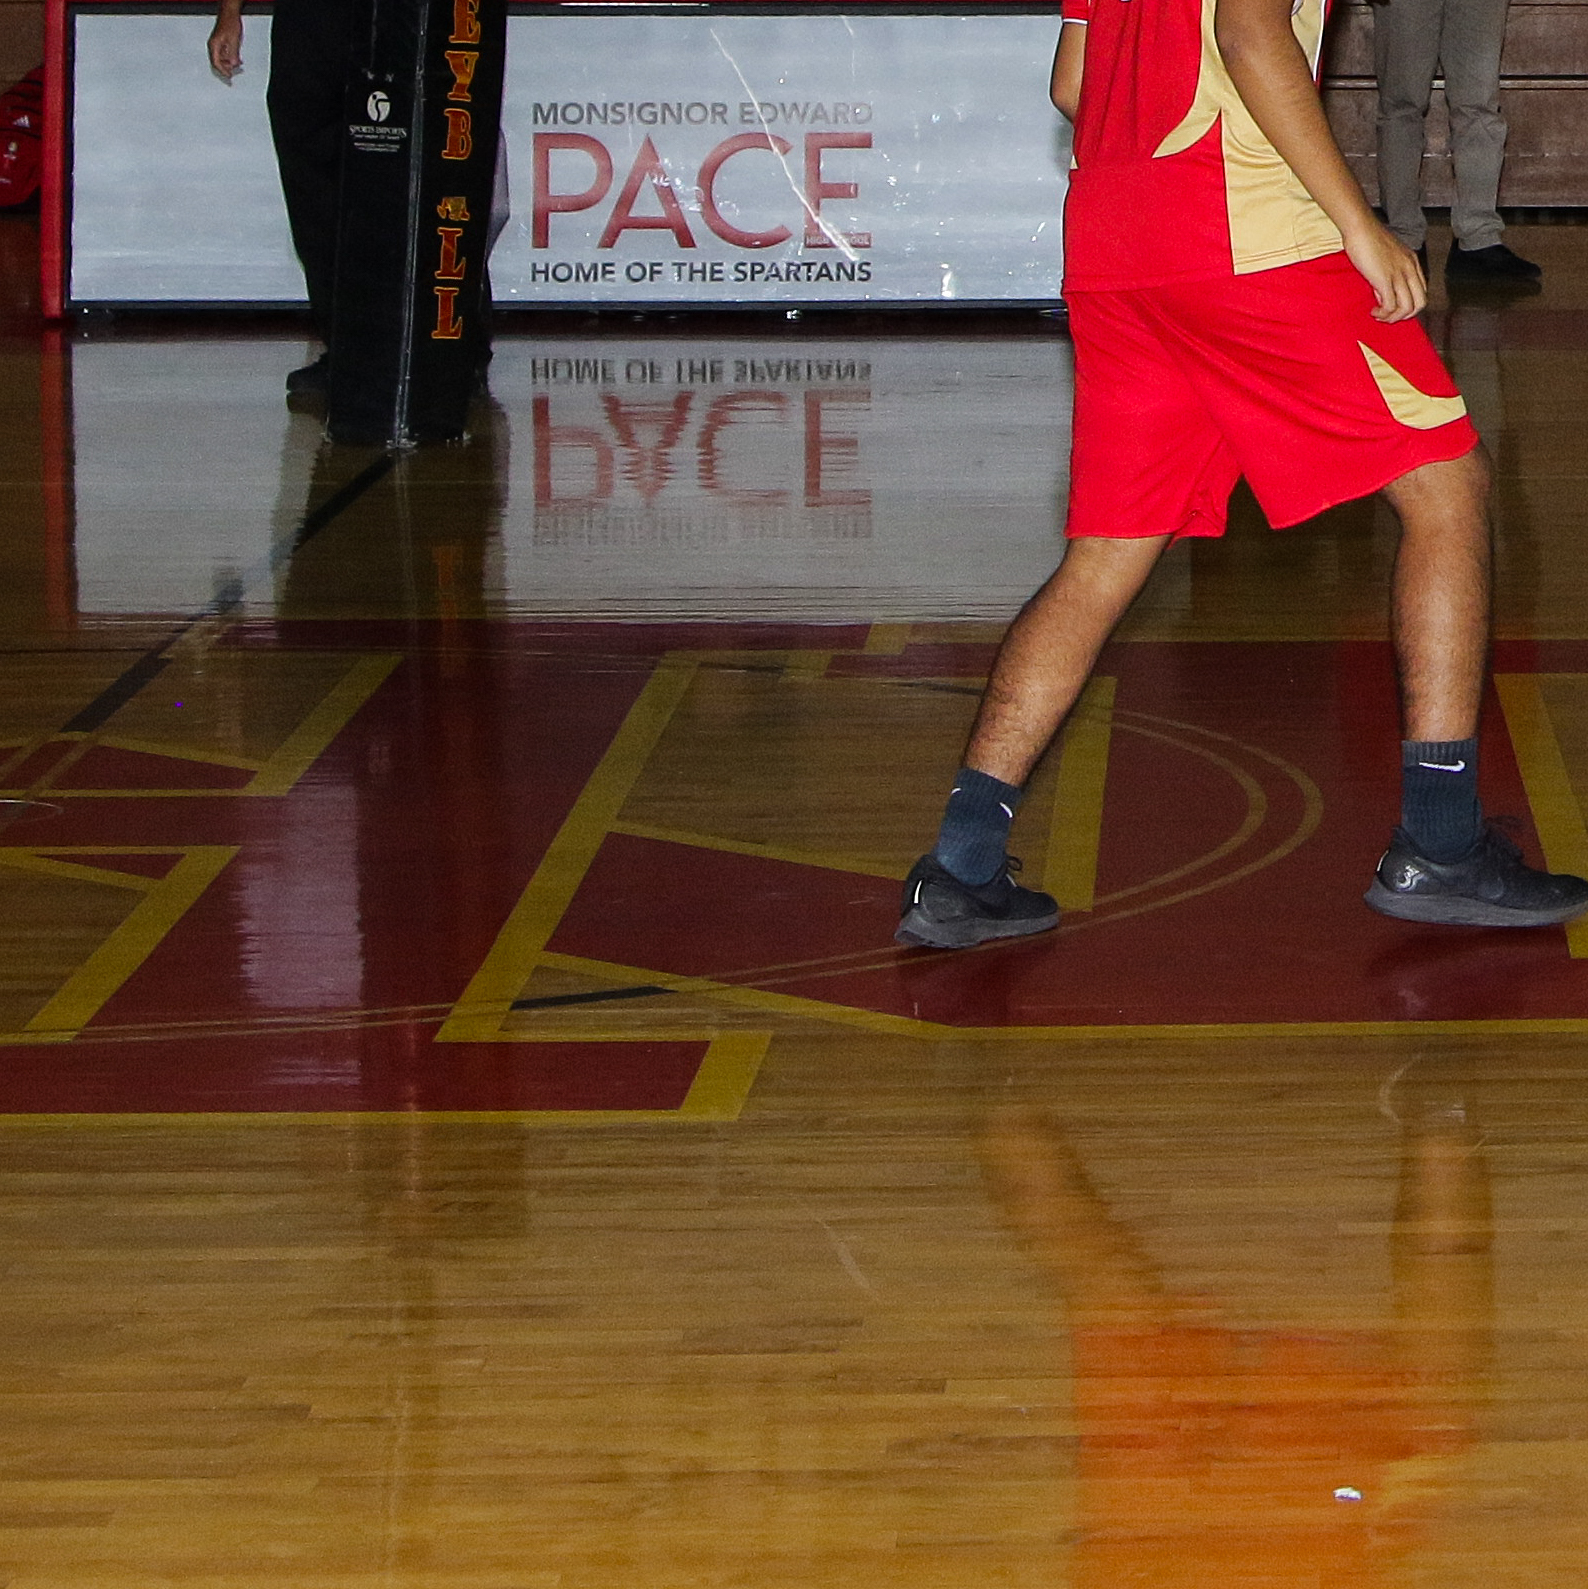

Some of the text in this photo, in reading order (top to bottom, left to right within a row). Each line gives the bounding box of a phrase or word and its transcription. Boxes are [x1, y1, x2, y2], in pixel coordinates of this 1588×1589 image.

[533, 102, 872, 125] MONSIGNOR EDWARD
[533, 132, 872, 248] PACE
[531, 262, 871, 283] HOME OF THE SPARTANS
